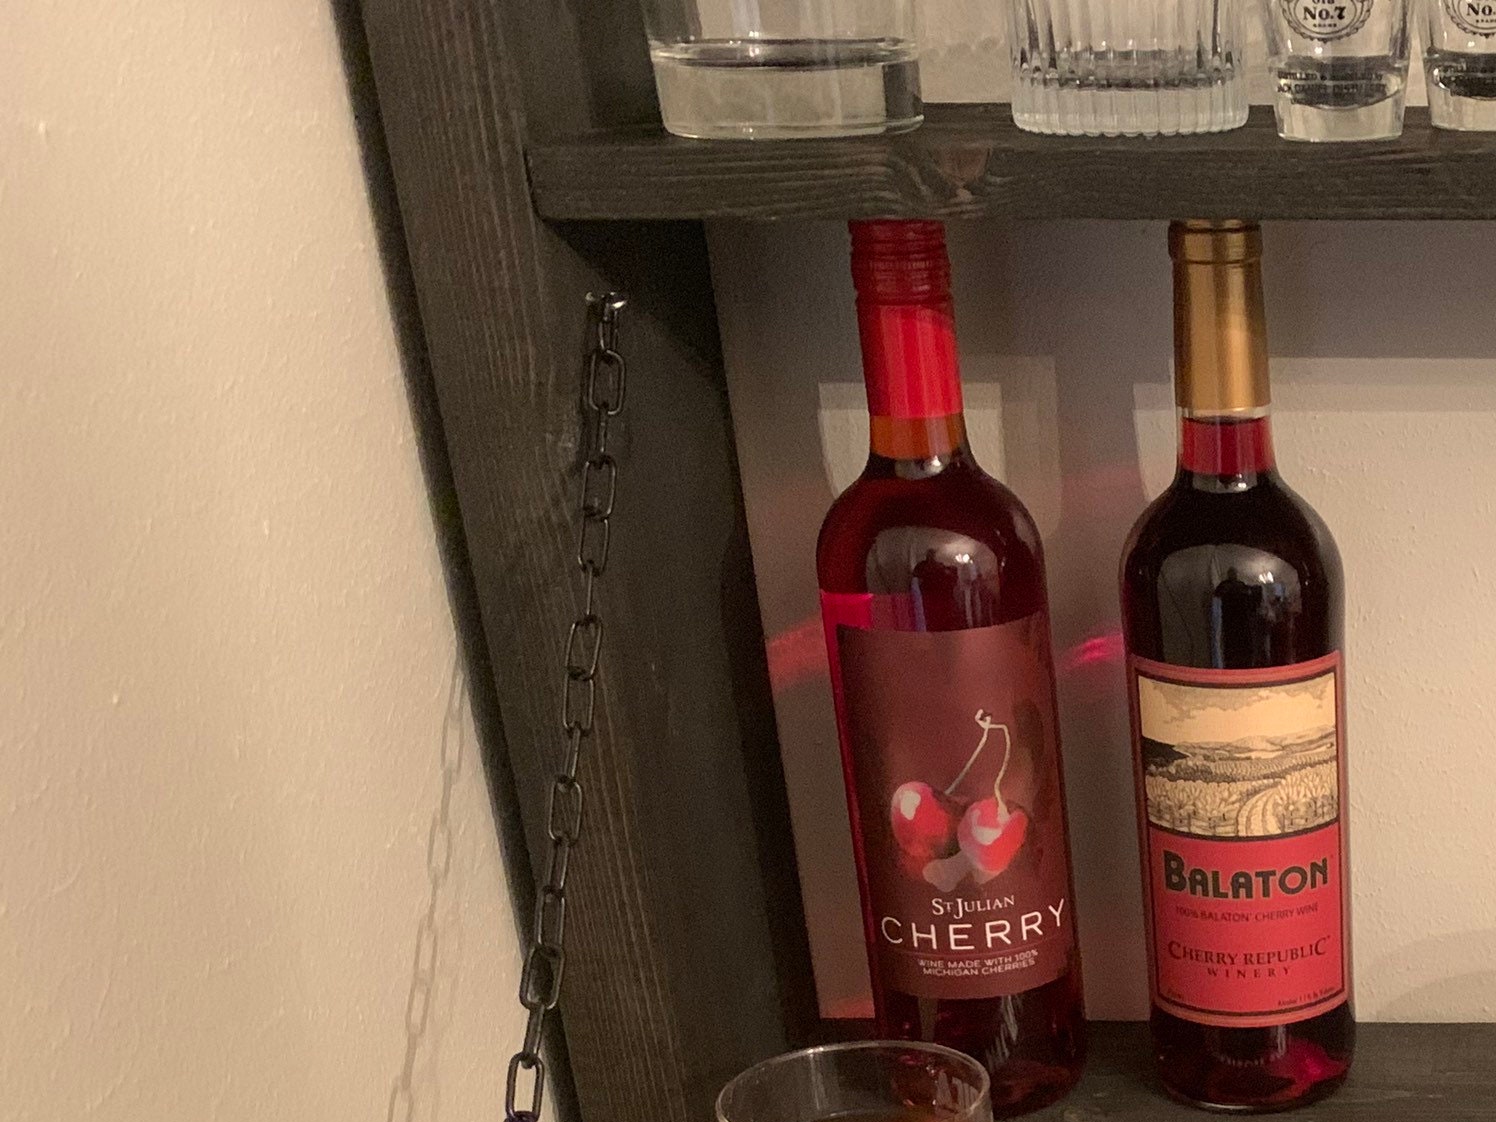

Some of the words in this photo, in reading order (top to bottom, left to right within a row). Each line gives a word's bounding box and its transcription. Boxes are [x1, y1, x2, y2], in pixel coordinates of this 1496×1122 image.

[1303, 6, 1346, 20] No.7
[1162, 850, 1329, 899] BALATON
[1254, 909, 1294, 922] CHERRY
[1296, 902, 1319, 916] WINE
[881, 899, 1065, 950] CHERRY
[919, 958, 944, 968] WINE
[947, 959, 981, 969] MADE
[985, 956, 1012, 967] WITH
[1014, 949, 1039, 962] 100%
[1167, 940, 1237, 965] CHERRY
[1243, 936, 1328, 965] REPUBLIC
[922, 967, 979, 977] MICHIGAN
[981, 958, 1036, 975] CHERRIES
[1207, 966, 1290, 978] WINERY
